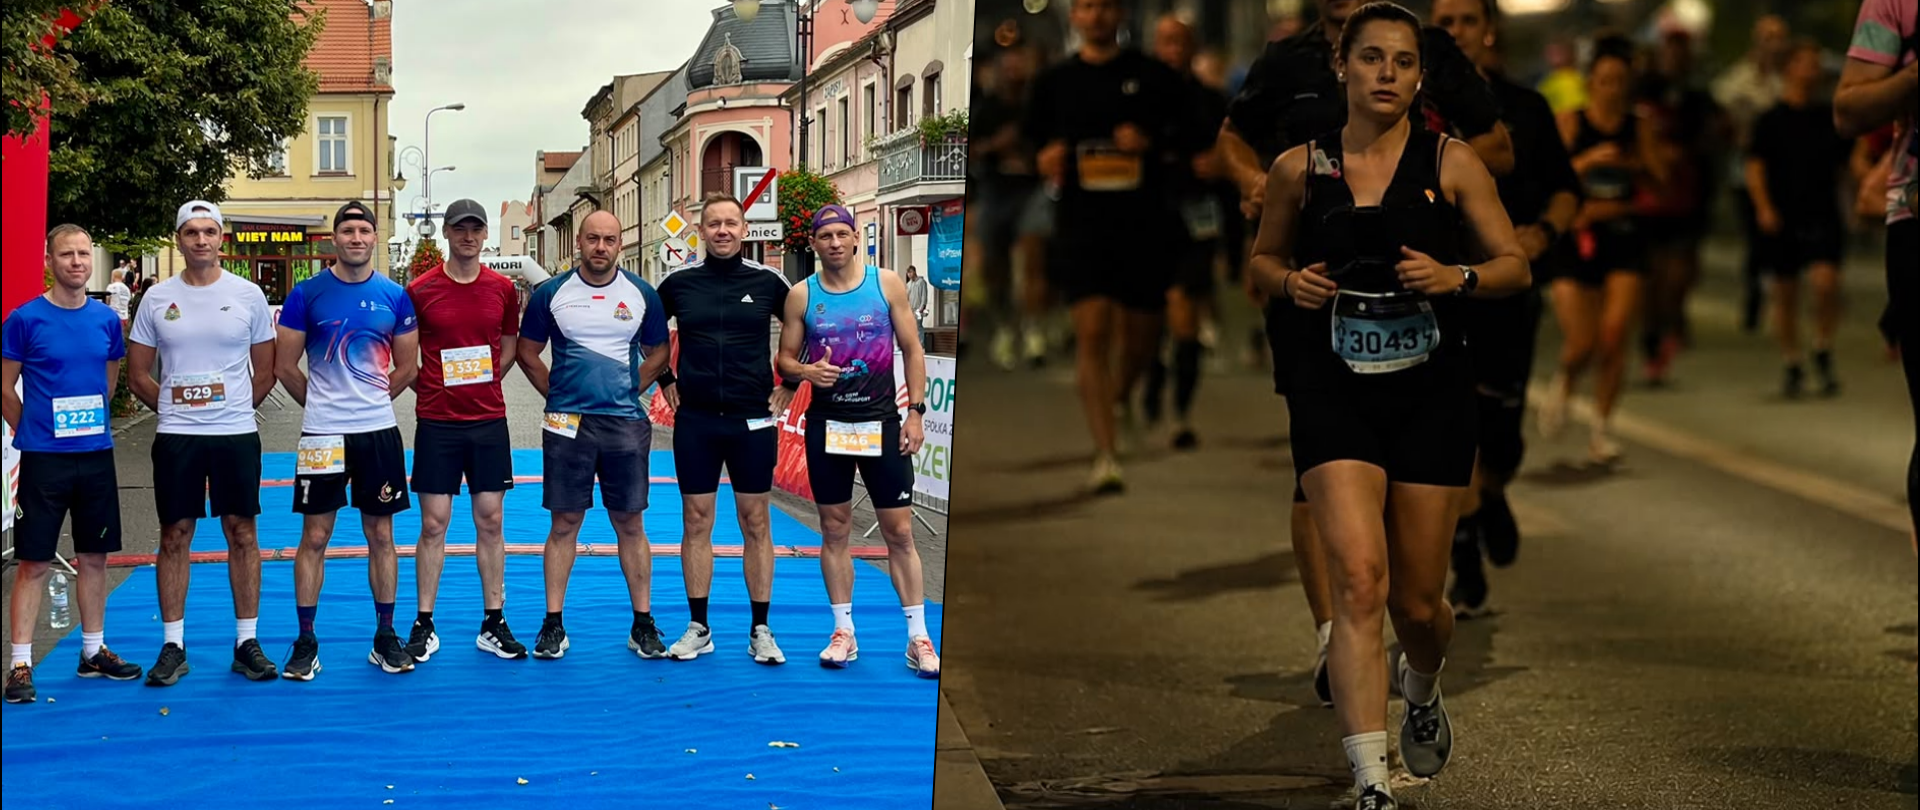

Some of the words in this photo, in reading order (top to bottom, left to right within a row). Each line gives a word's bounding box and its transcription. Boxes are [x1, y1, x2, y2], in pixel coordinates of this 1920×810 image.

[236, 232, 268, 242] VIET
[271, 232, 303, 242] NAM
[489, 261, 522, 270] MORI
[456, 360, 481, 374] 332
[183, 386, 212, 401] 629
[69, 410, 96, 425] 222
[839, 434, 869, 446] 346
[306, 449, 333, 463] 457
[300, 479, 312, 504] 7
